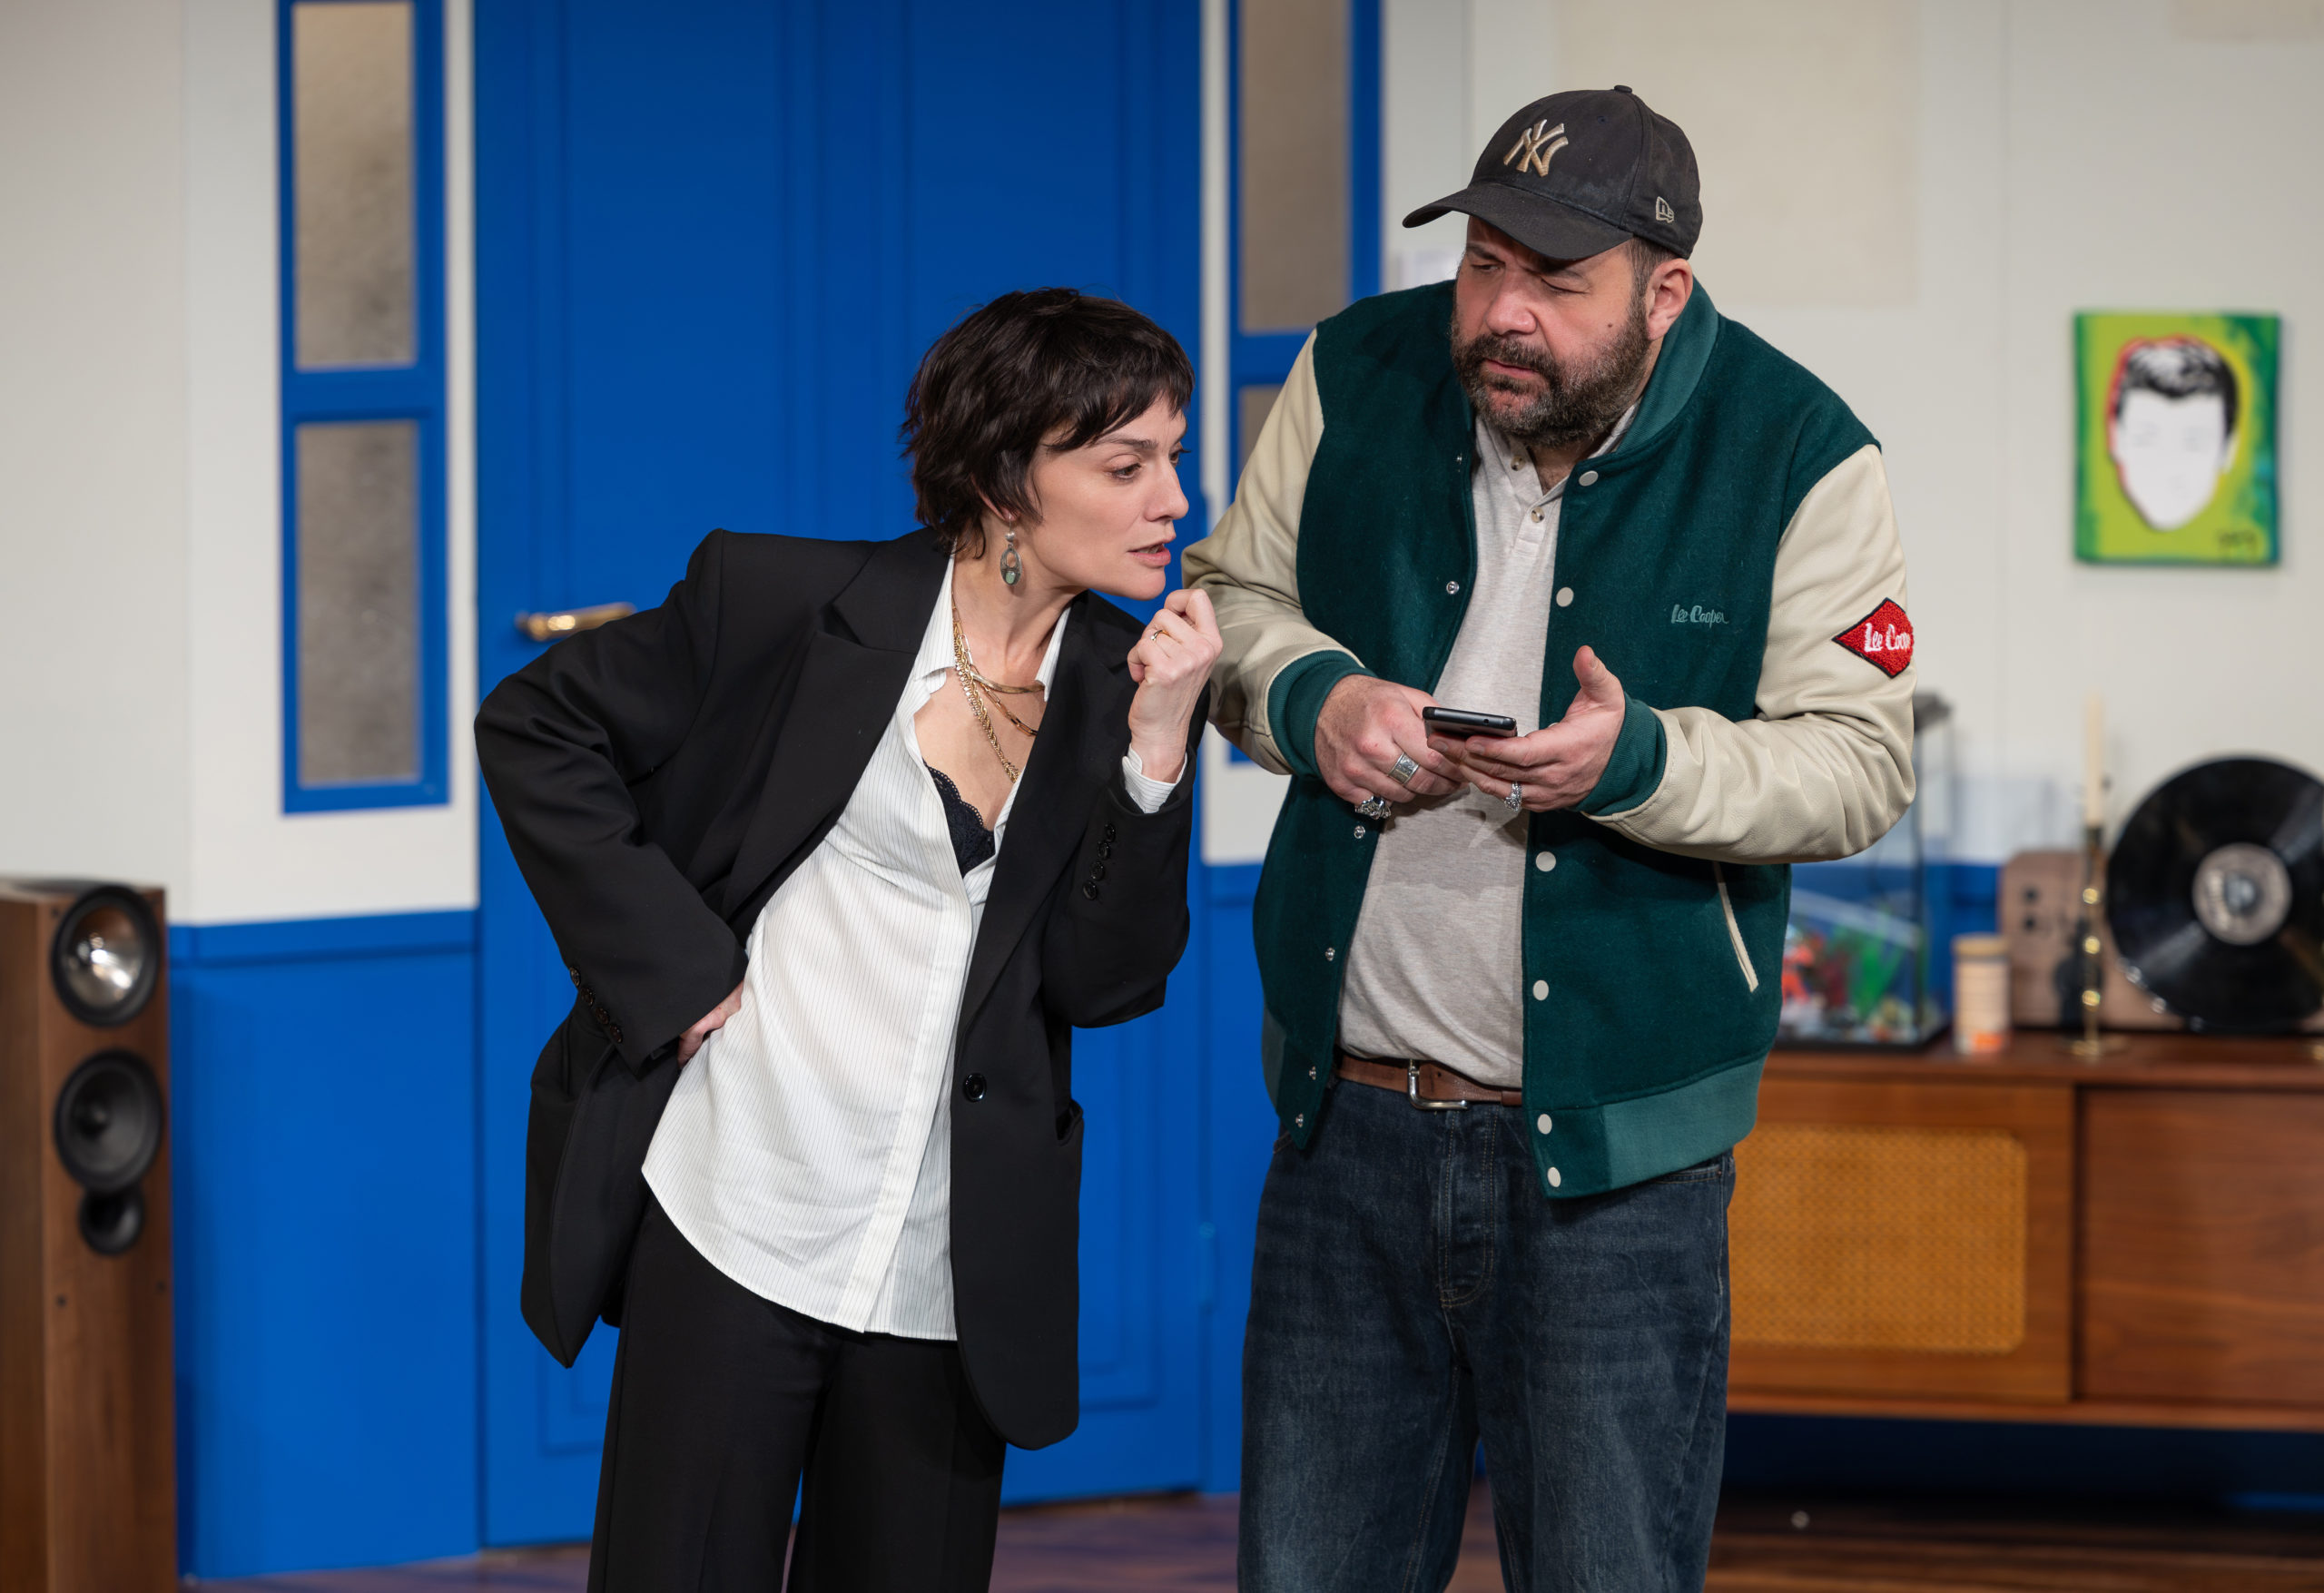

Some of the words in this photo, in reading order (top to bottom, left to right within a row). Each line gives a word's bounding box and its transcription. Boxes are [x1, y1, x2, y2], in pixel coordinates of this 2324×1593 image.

[1502, 119, 1569, 177] NY
[1670, 604, 1689, 624] Lee
[1689, 605, 1729, 628] Cooper
[1864, 622, 1884, 653] Lee
